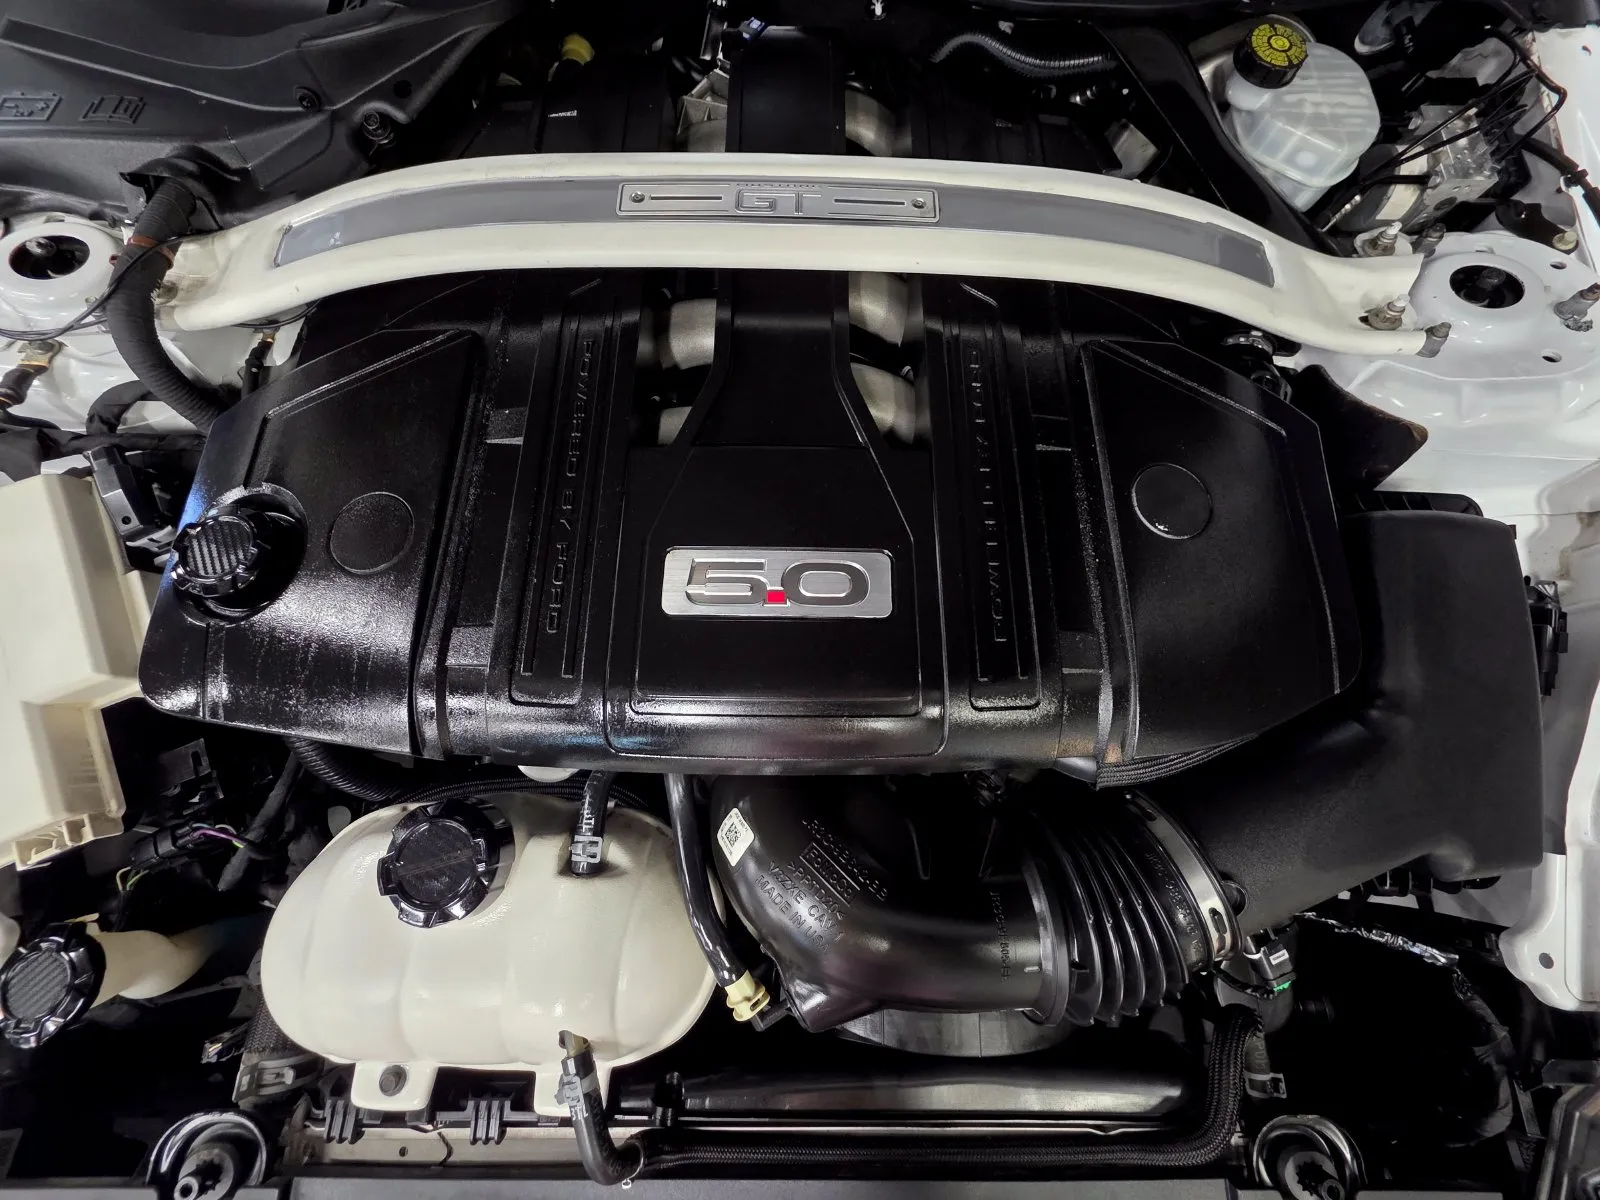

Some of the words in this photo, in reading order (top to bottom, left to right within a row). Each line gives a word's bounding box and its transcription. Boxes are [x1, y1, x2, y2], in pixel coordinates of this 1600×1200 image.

[735, 187, 822, 215] GT
[684, 556, 871, 607] 5.0
[755, 874, 792, 915] MADE
[790, 911, 807, 929] IN
[805, 924, 831, 952] USA
